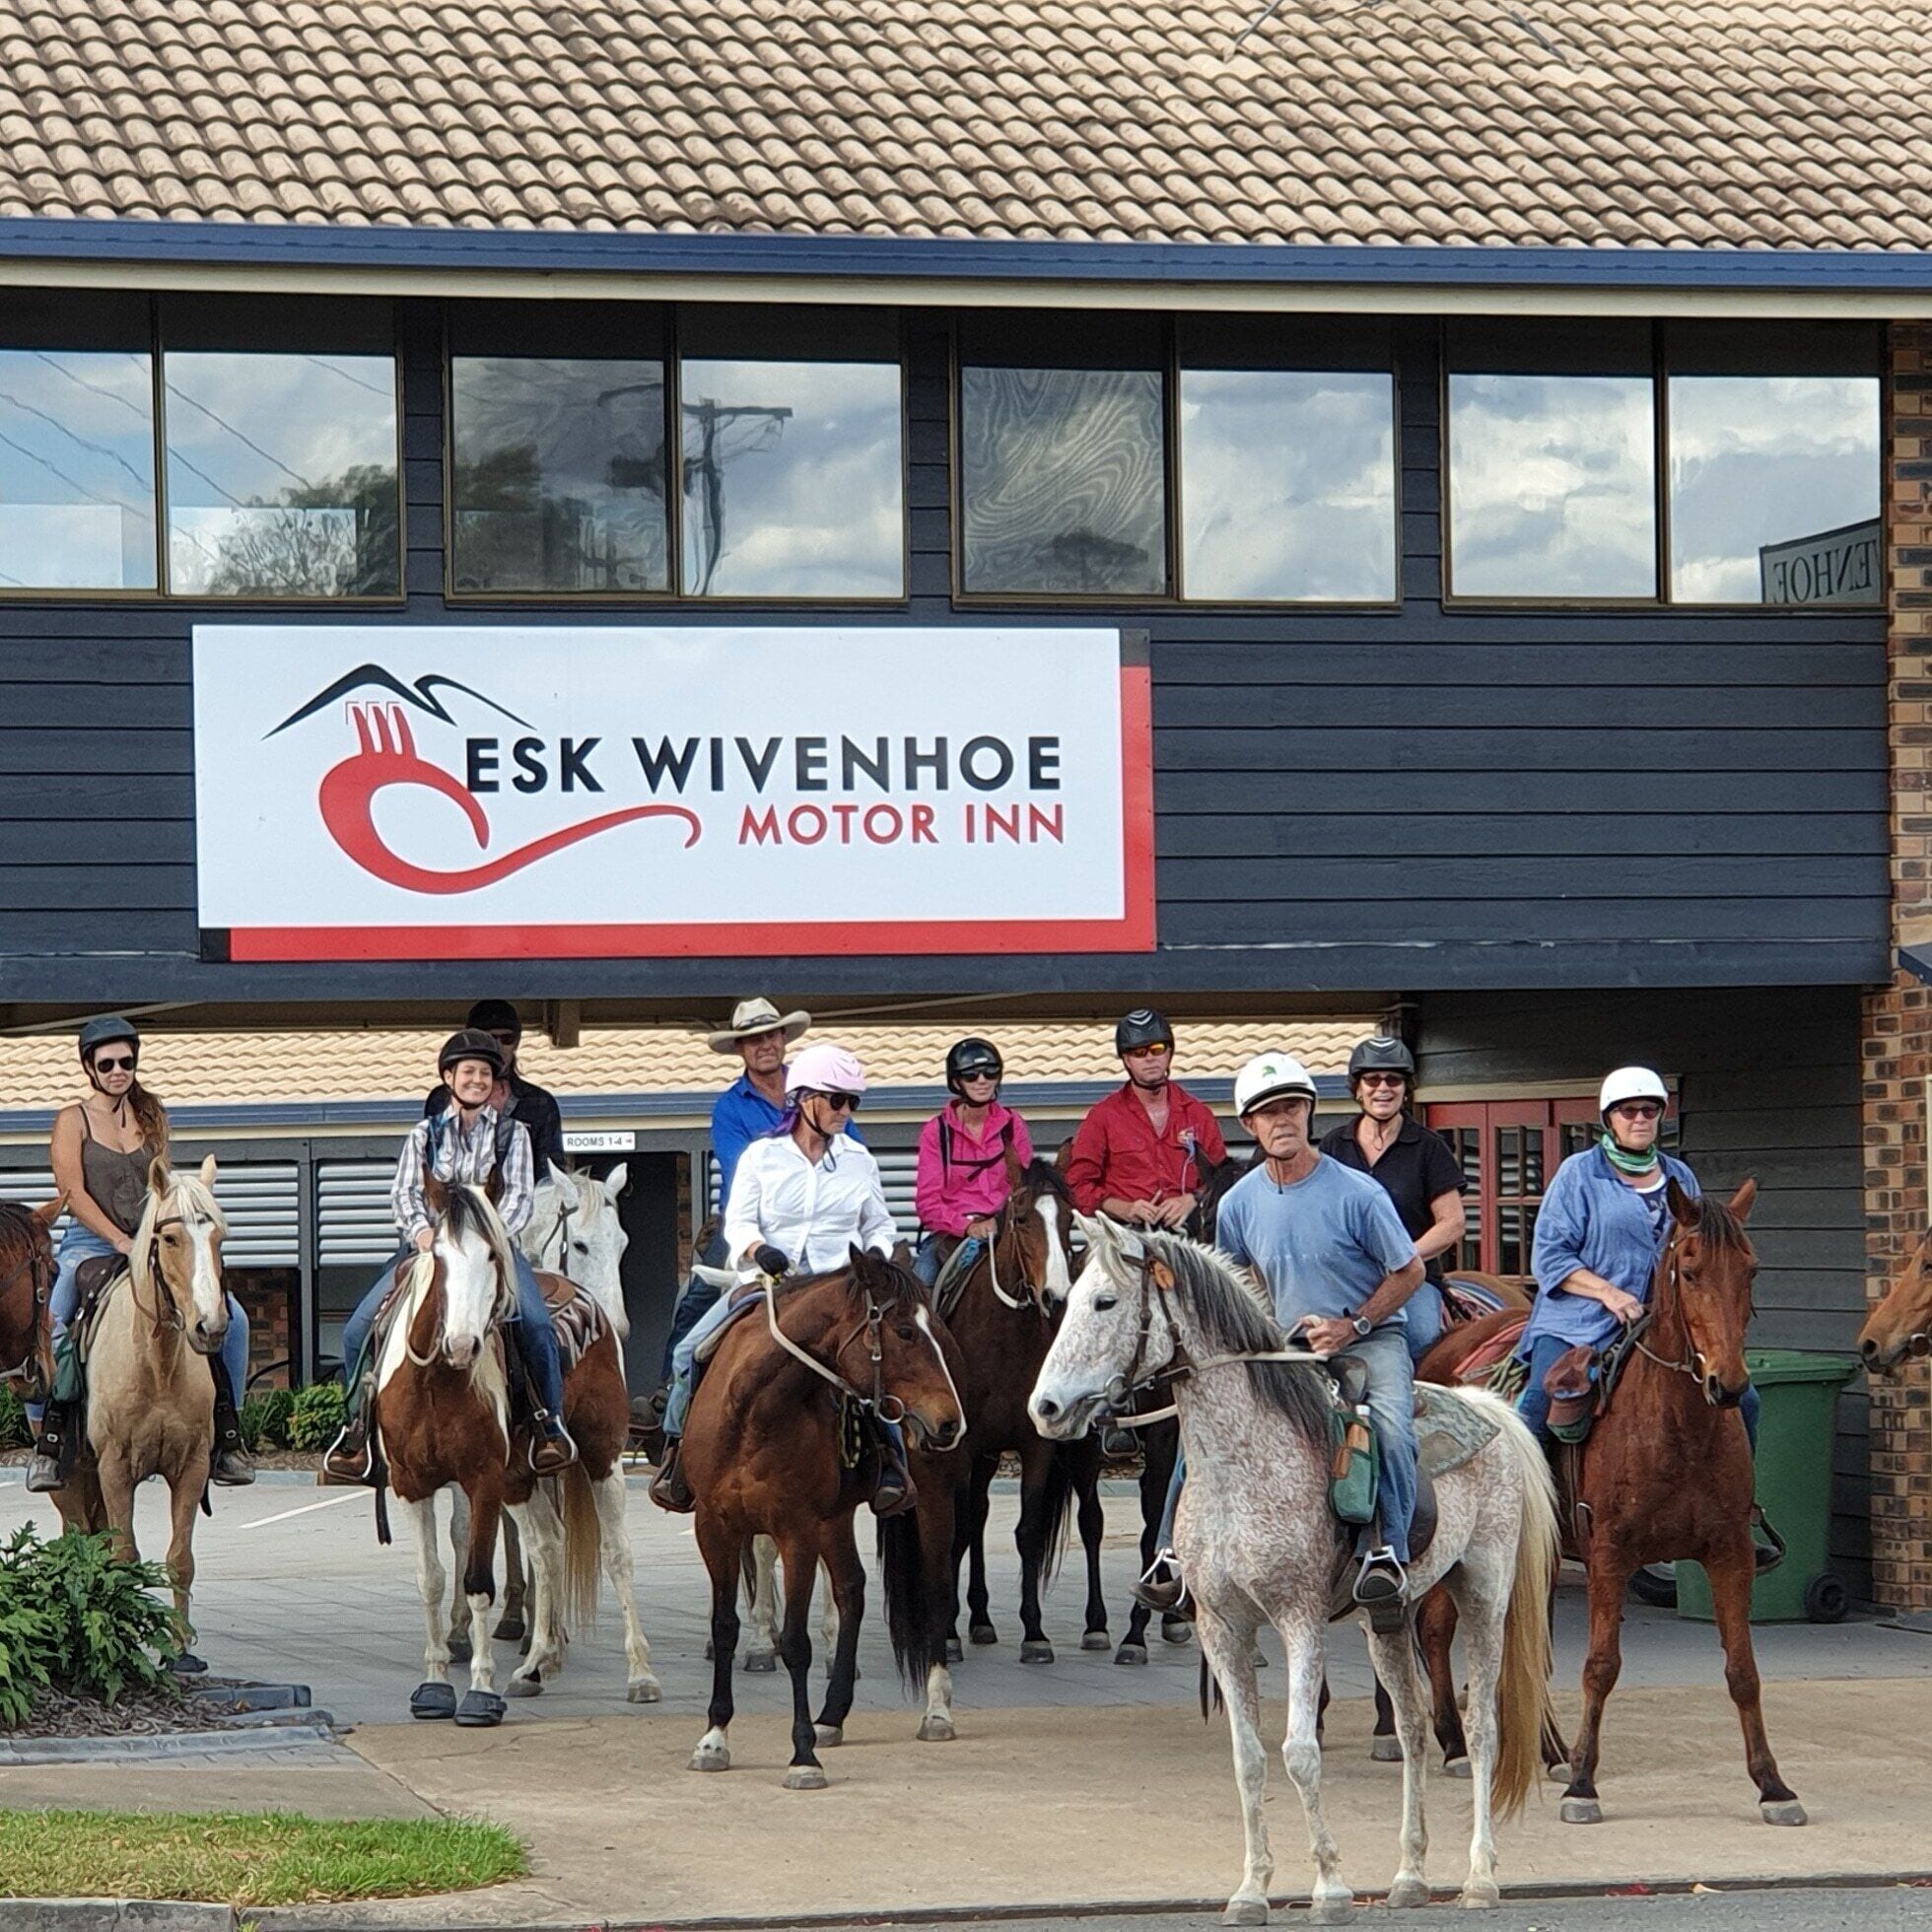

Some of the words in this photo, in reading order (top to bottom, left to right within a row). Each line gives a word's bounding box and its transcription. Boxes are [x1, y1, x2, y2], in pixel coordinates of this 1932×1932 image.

[466, 736, 605, 794] ESK
[631, 734, 1061, 794] WIVENHOE
[739, 803, 938, 846] MOTOR
[967, 802, 1064, 845] INN
[567, 1137, 604, 1147] ROOMS
[608, 1137, 623, 1146] 1-4
